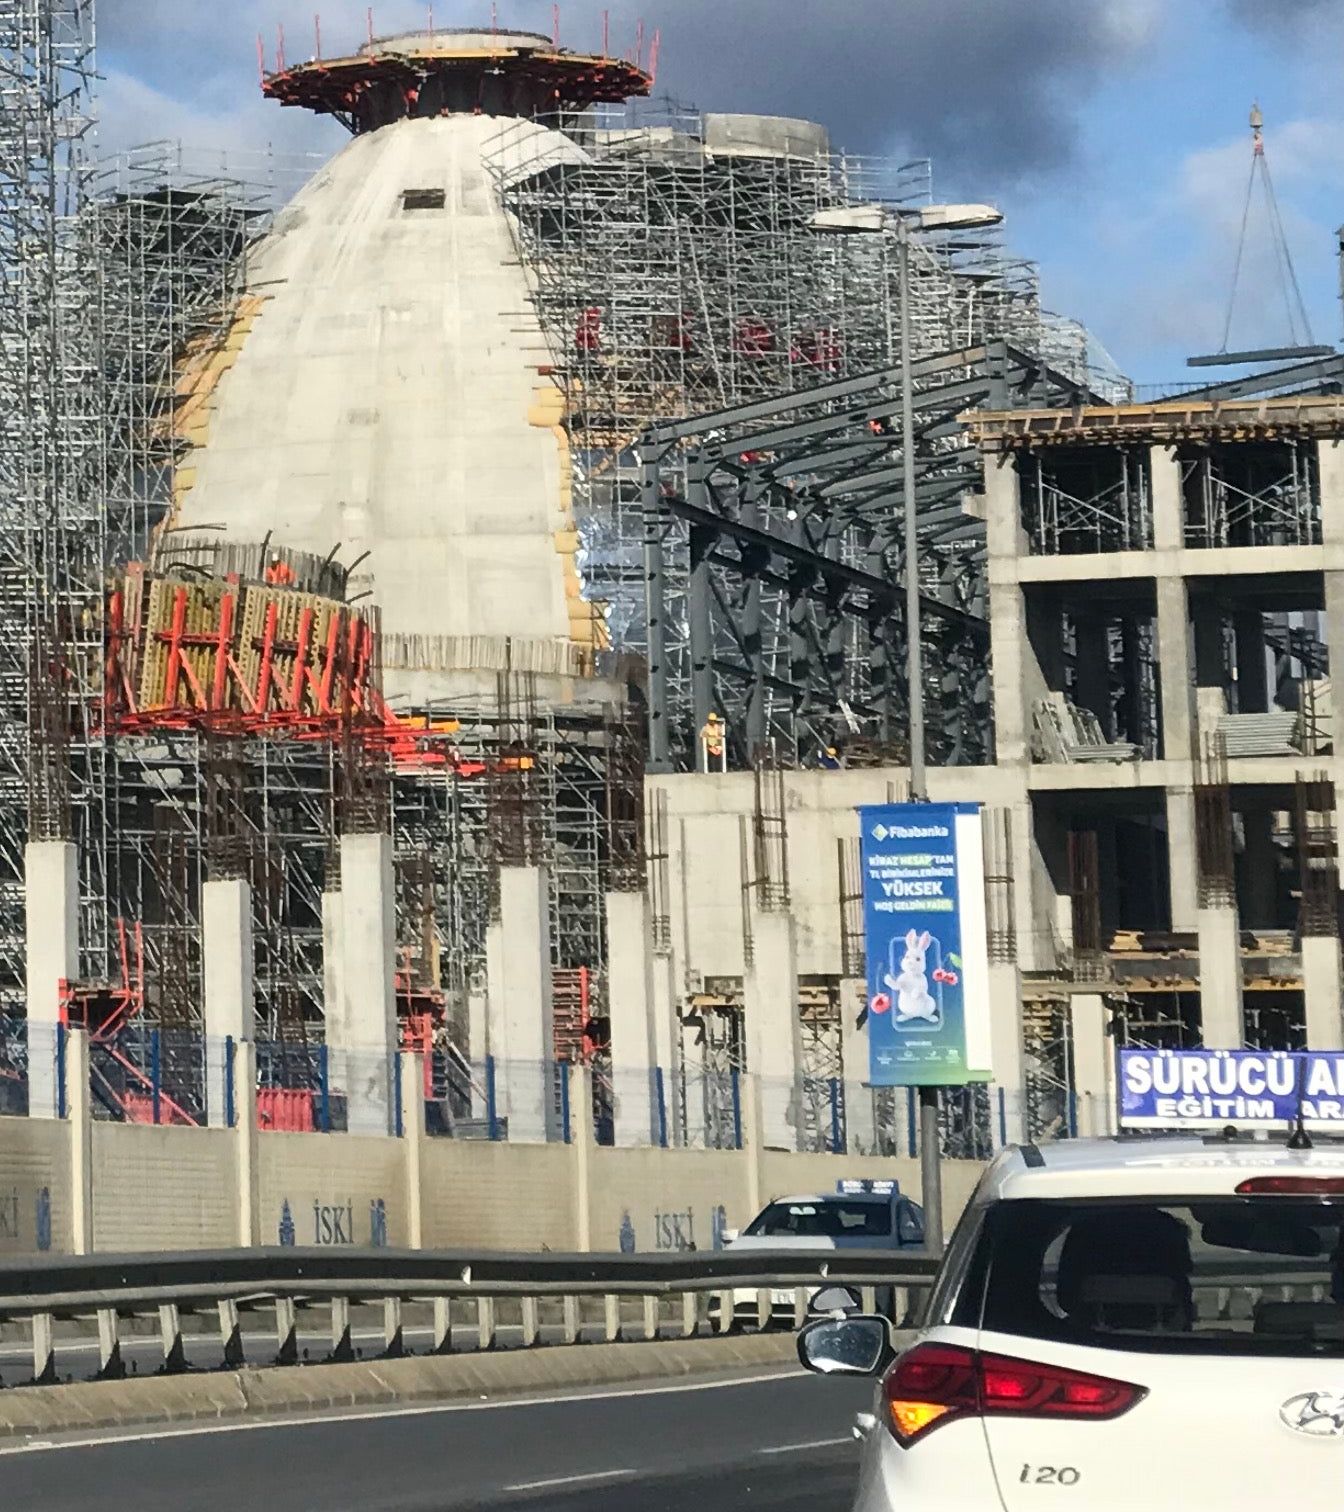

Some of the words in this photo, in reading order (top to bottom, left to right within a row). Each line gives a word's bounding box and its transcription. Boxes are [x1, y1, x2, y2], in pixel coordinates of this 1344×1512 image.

[889, 825, 949, 838] Fibabanka
[881, 879, 944, 897] YÜKSEK
[1125, 1050, 1296, 1096] SÜRÜCÜ
[1307, 1058, 1344, 1096] A
[1156, 1095, 1275, 1118] EĞİTİM
[1295, 1100, 1344, 1119] AR
[312, 1198, 354, 1245] İSKİ
